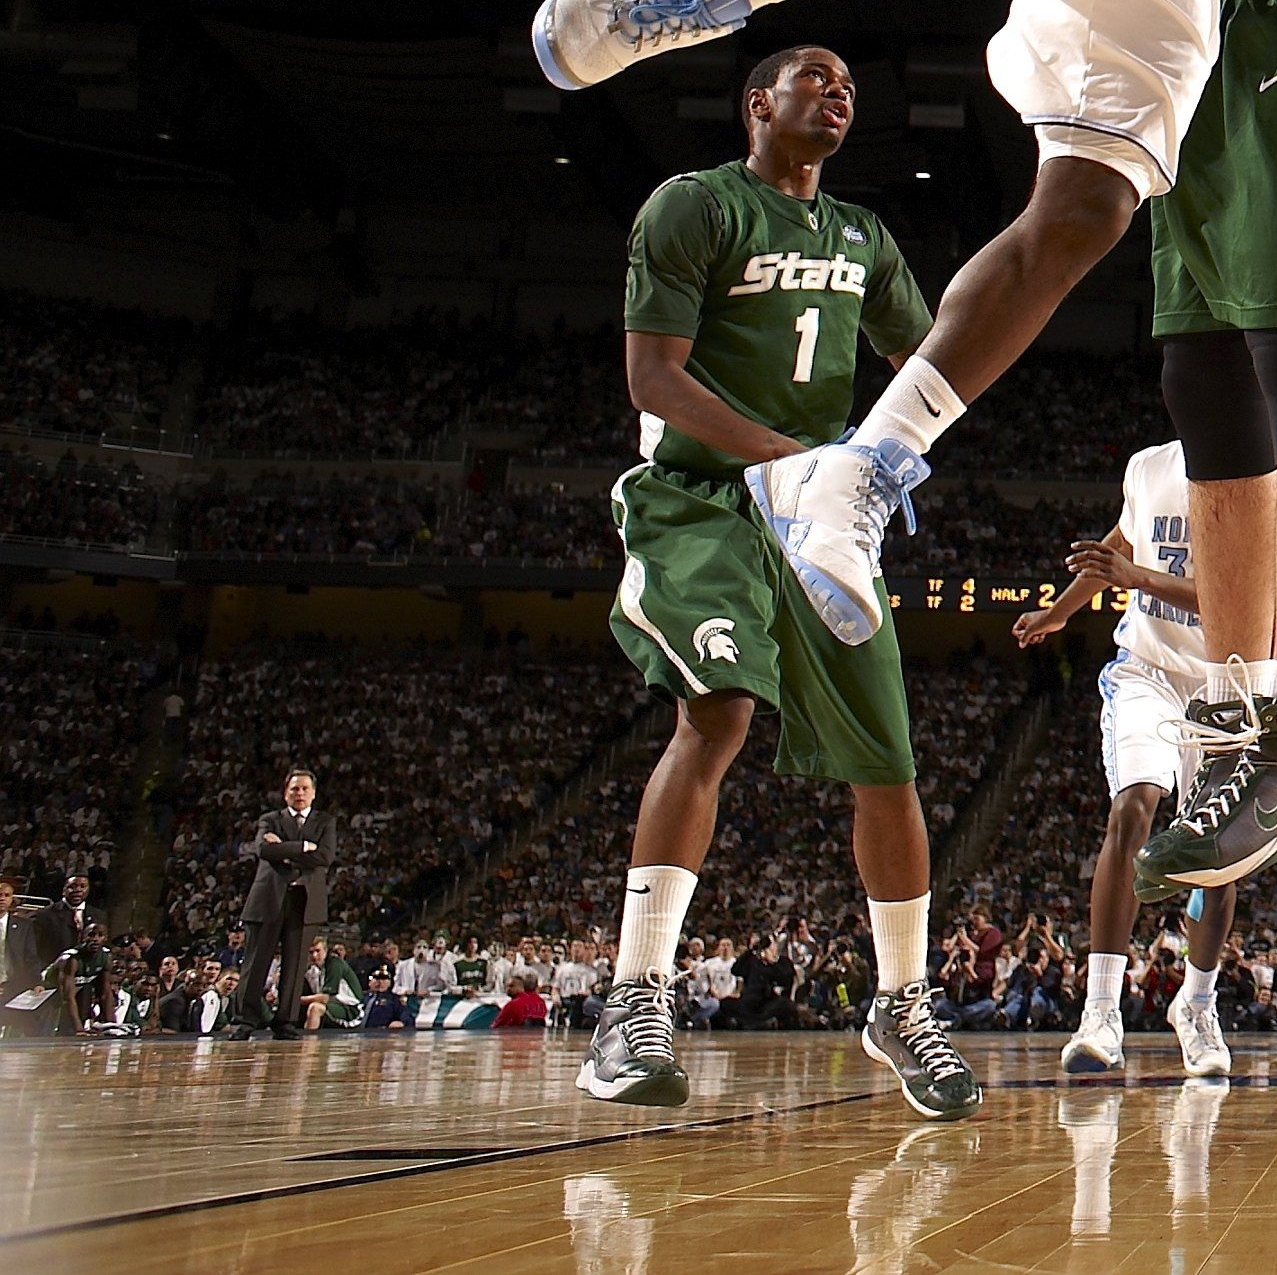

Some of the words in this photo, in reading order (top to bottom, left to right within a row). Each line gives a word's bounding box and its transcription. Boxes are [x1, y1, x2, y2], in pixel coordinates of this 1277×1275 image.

[726, 250, 867, 298] State
[791, 305, 821, 384] 1
[928, 578, 945, 593] TF
[961, 577, 976, 594] 4
[991, 587, 1031, 602] HALF
[1039, 583, 1056, 609] 2
[927, 595, 943, 610] TF
[960, 595, 976, 612] 2
